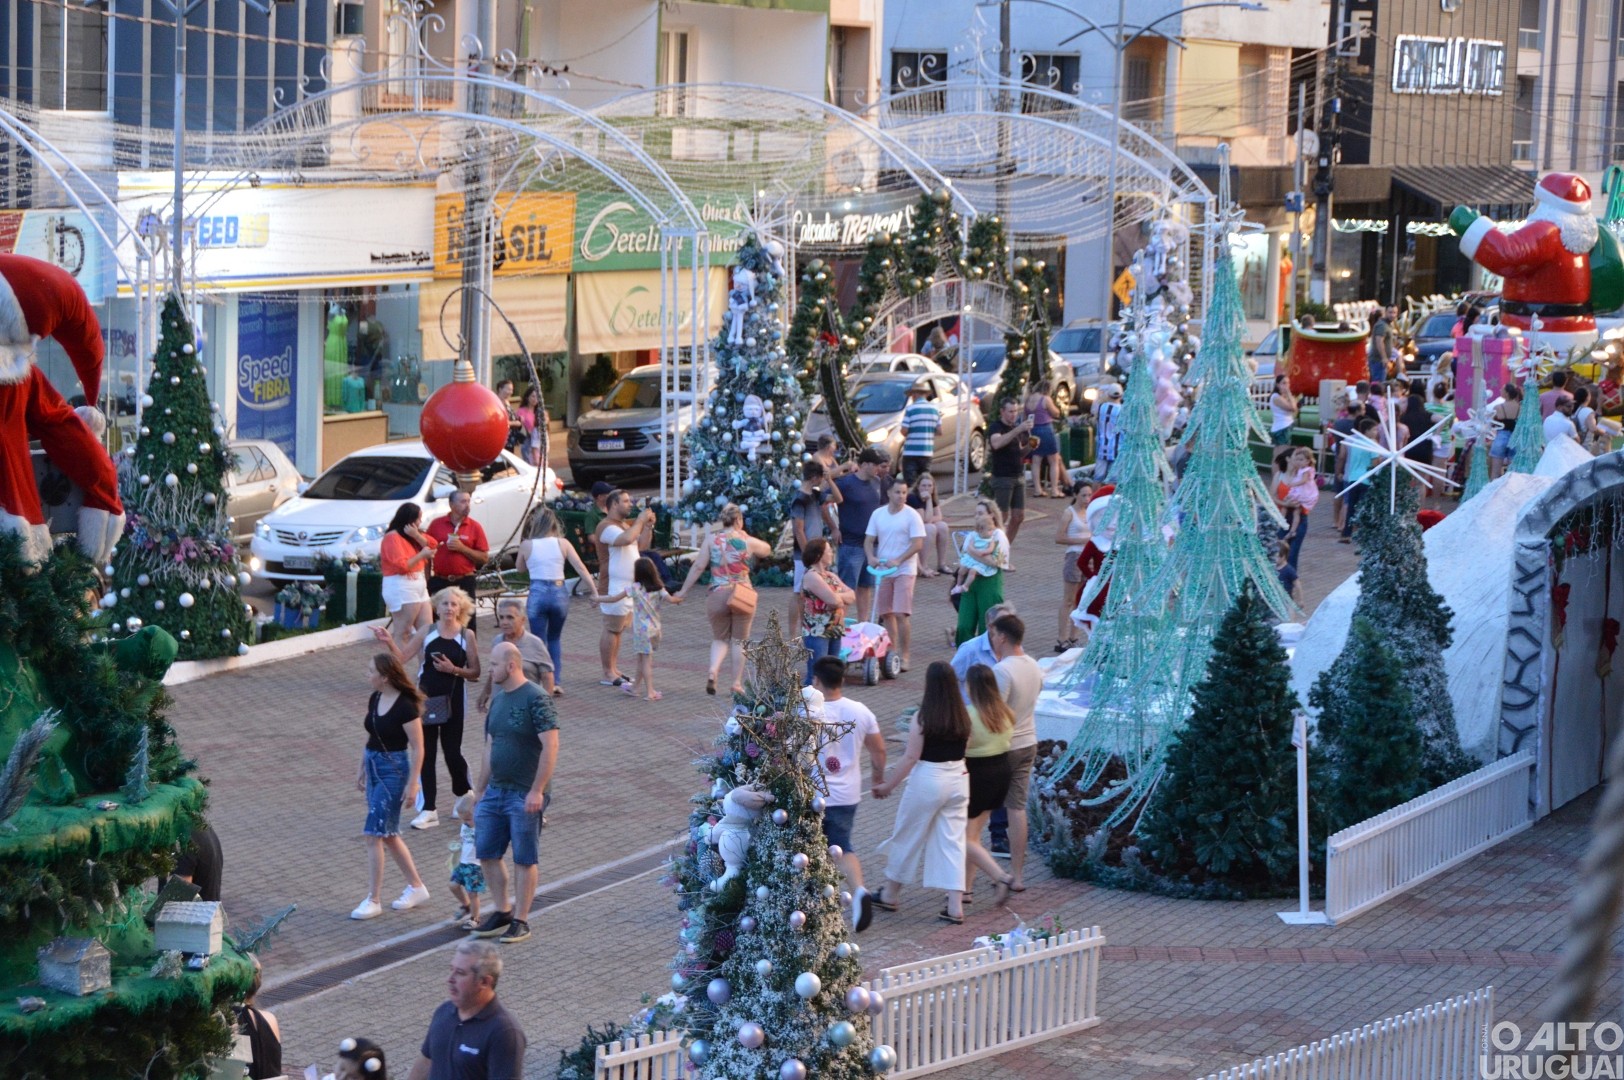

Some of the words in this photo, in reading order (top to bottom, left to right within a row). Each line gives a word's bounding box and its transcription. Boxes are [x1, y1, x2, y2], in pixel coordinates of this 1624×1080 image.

[446, 223, 553, 264] BSIL
[239, 346, 292, 392] Speed
[253, 377, 291, 402] FIBRA
